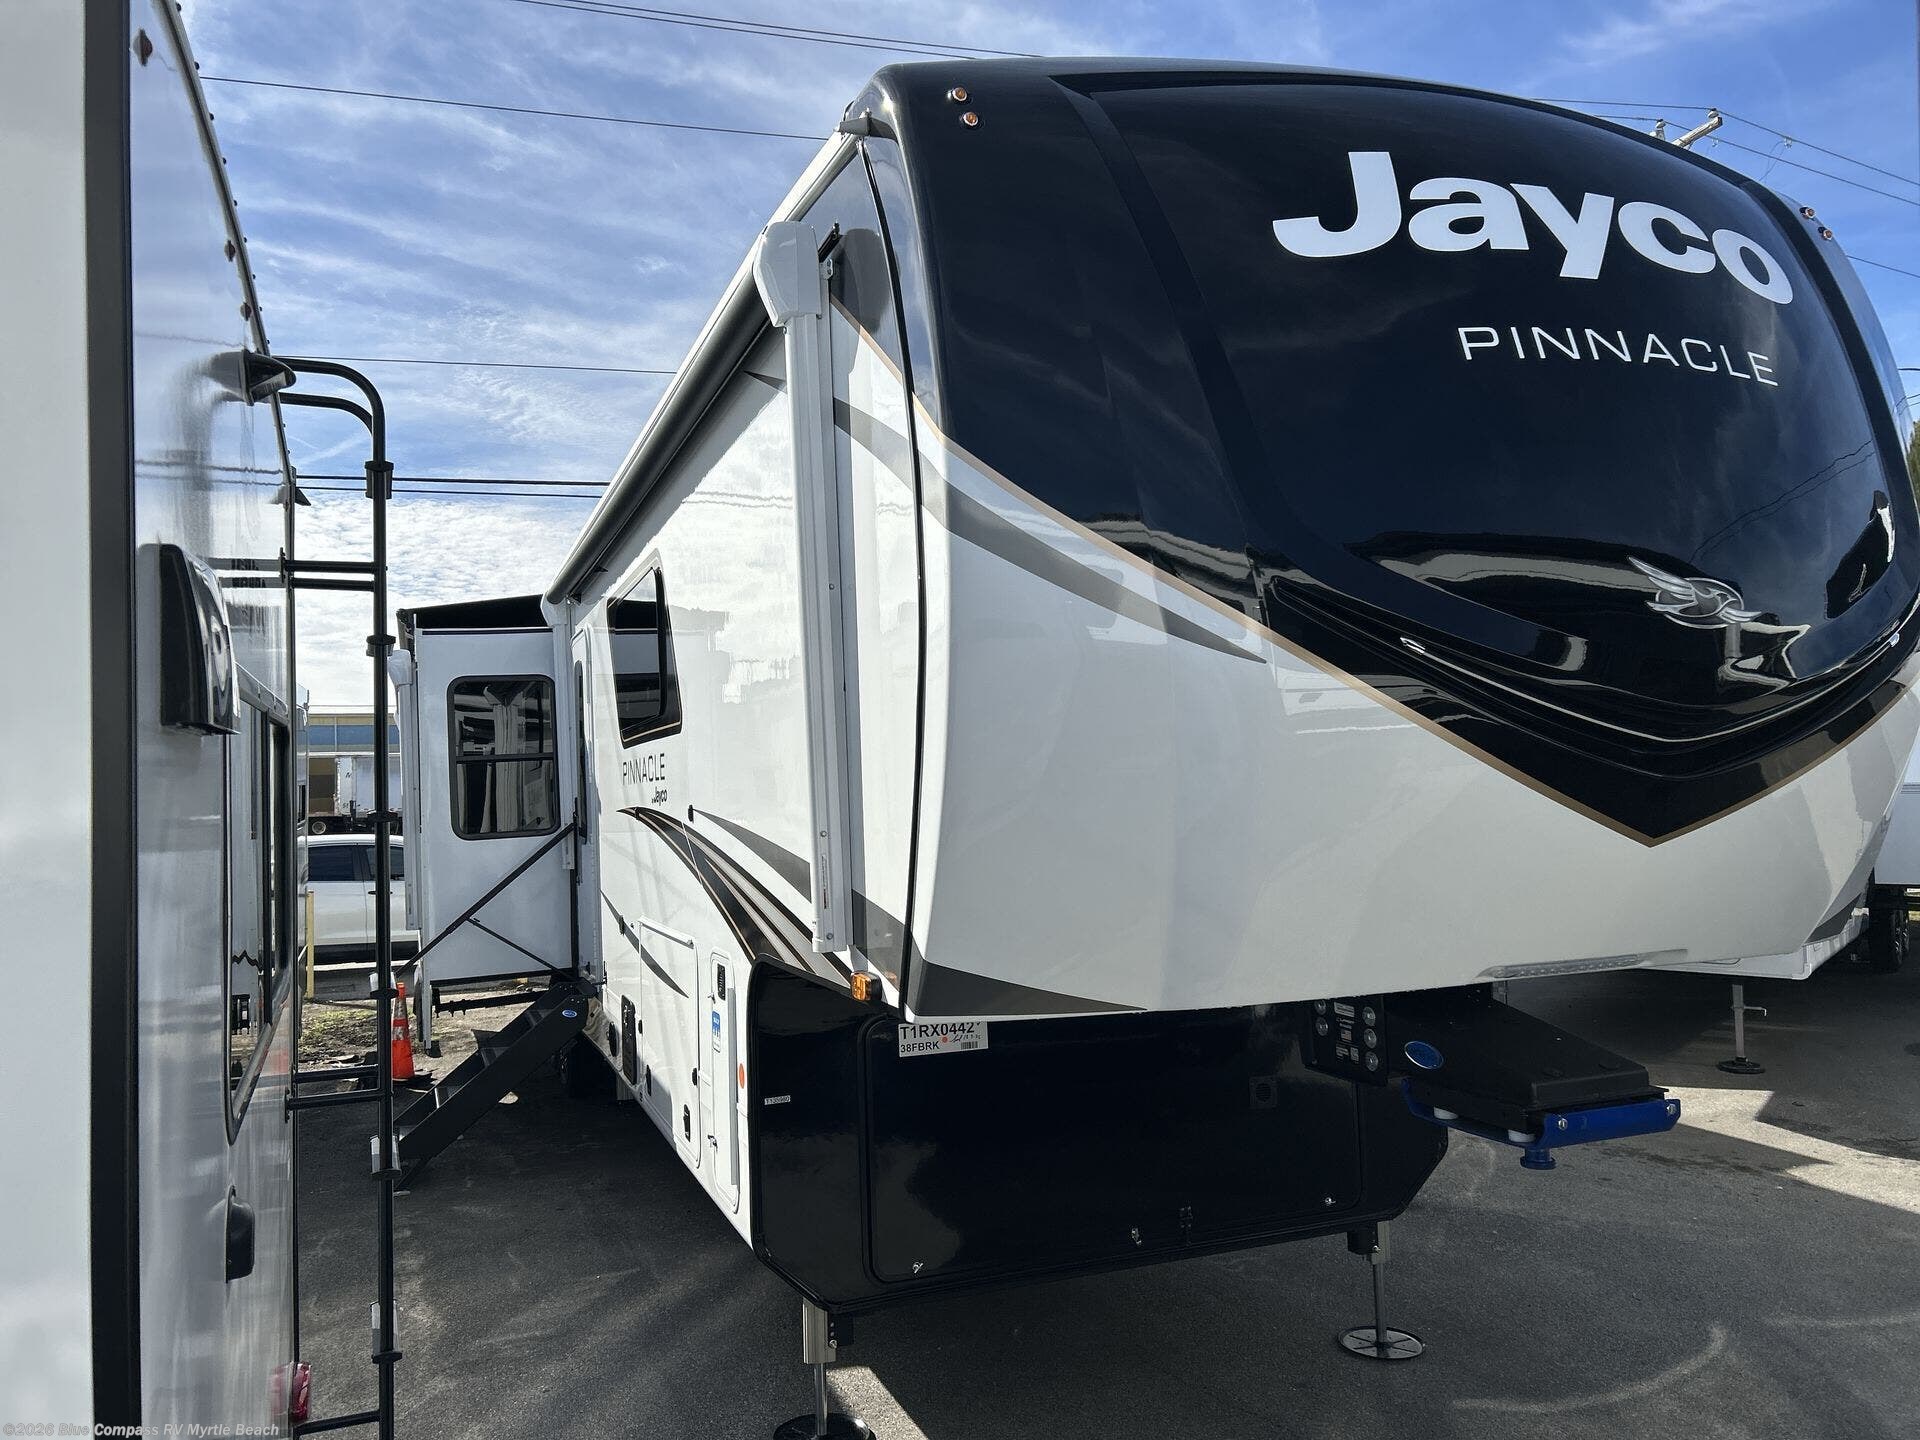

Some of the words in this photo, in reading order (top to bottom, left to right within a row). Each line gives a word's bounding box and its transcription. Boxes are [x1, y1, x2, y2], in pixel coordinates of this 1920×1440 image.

[1273, 151, 1794, 305] Jayco
[1457, 326, 1779, 387] PINNACLE
[622, 752, 666, 786] PINNACLE
[900, 1022, 975, 1040] T1RX0442
[900, 1040, 940, 1053] 38FBRK
